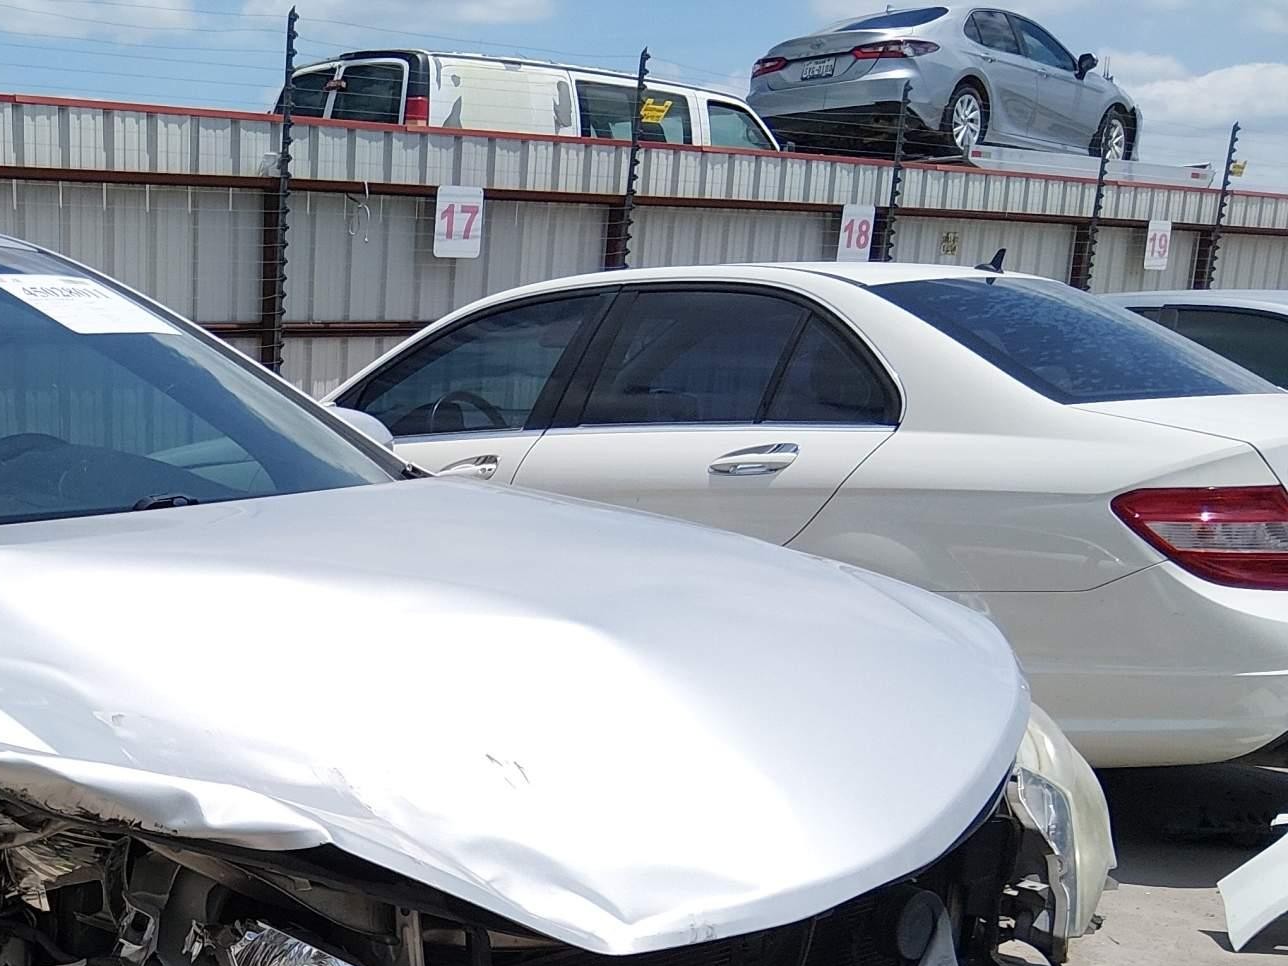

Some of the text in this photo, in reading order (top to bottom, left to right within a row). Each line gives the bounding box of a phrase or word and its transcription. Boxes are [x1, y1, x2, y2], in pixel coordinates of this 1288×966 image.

[441, 204, 479, 240] 17
[843, 218, 871, 250] 18
[1149, 232, 1169, 258] 19
